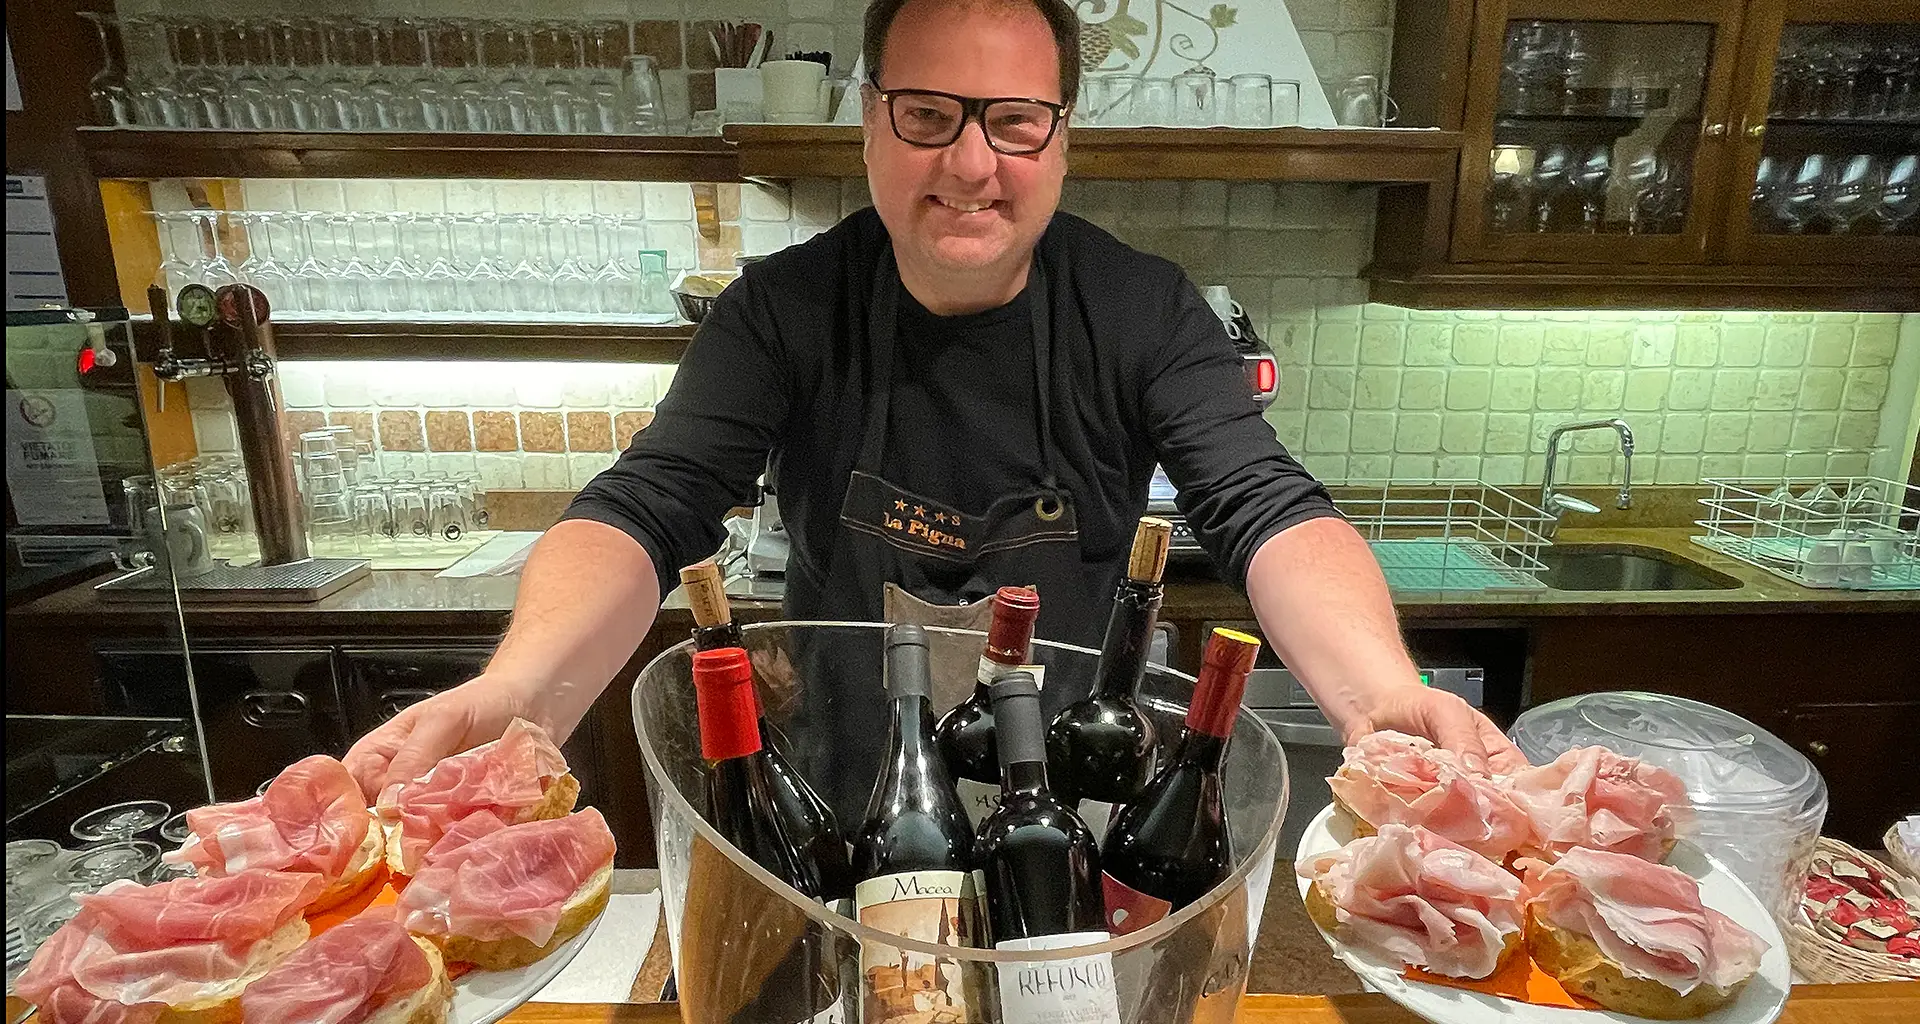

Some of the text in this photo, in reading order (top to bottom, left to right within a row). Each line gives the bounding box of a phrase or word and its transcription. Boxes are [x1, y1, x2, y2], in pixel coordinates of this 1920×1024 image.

[907, 519, 967, 550] Pigna
[891, 875, 953, 901] Macea
[1018, 962, 1107, 996] REFOSCO
